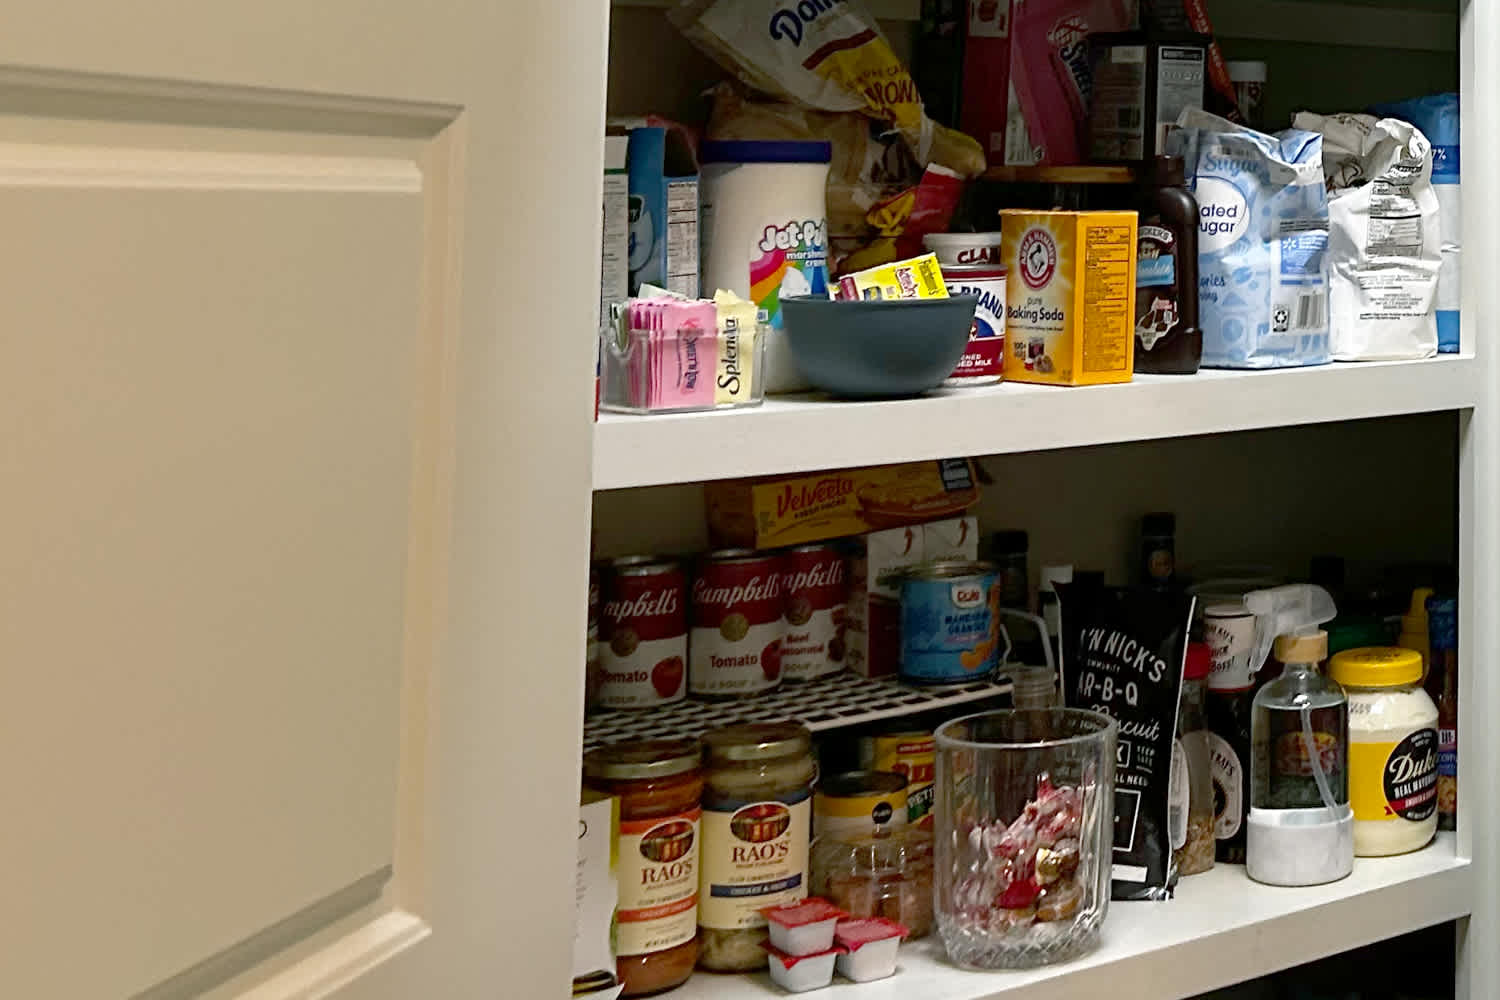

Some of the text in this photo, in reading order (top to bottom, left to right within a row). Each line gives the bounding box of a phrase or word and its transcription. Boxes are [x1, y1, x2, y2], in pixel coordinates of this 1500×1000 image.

[1200, 220, 1236, 236] ugar
[1007, 305, 1065, 324] Baking Soda
[716, 318, 742, 396] Splenda
[974, 358, 992, 367] MILK
[776, 478, 854, 518] Velveeta
[781, 559, 844, 594] mpbell's
[602, 586, 677, 623] mpbell's
[710, 654, 758, 669] Tomato
[1103, 629, 1167, 683] NICK'S
[731, 840, 790, 863] RAO'S
[640, 857, 694, 885] RAO'S
